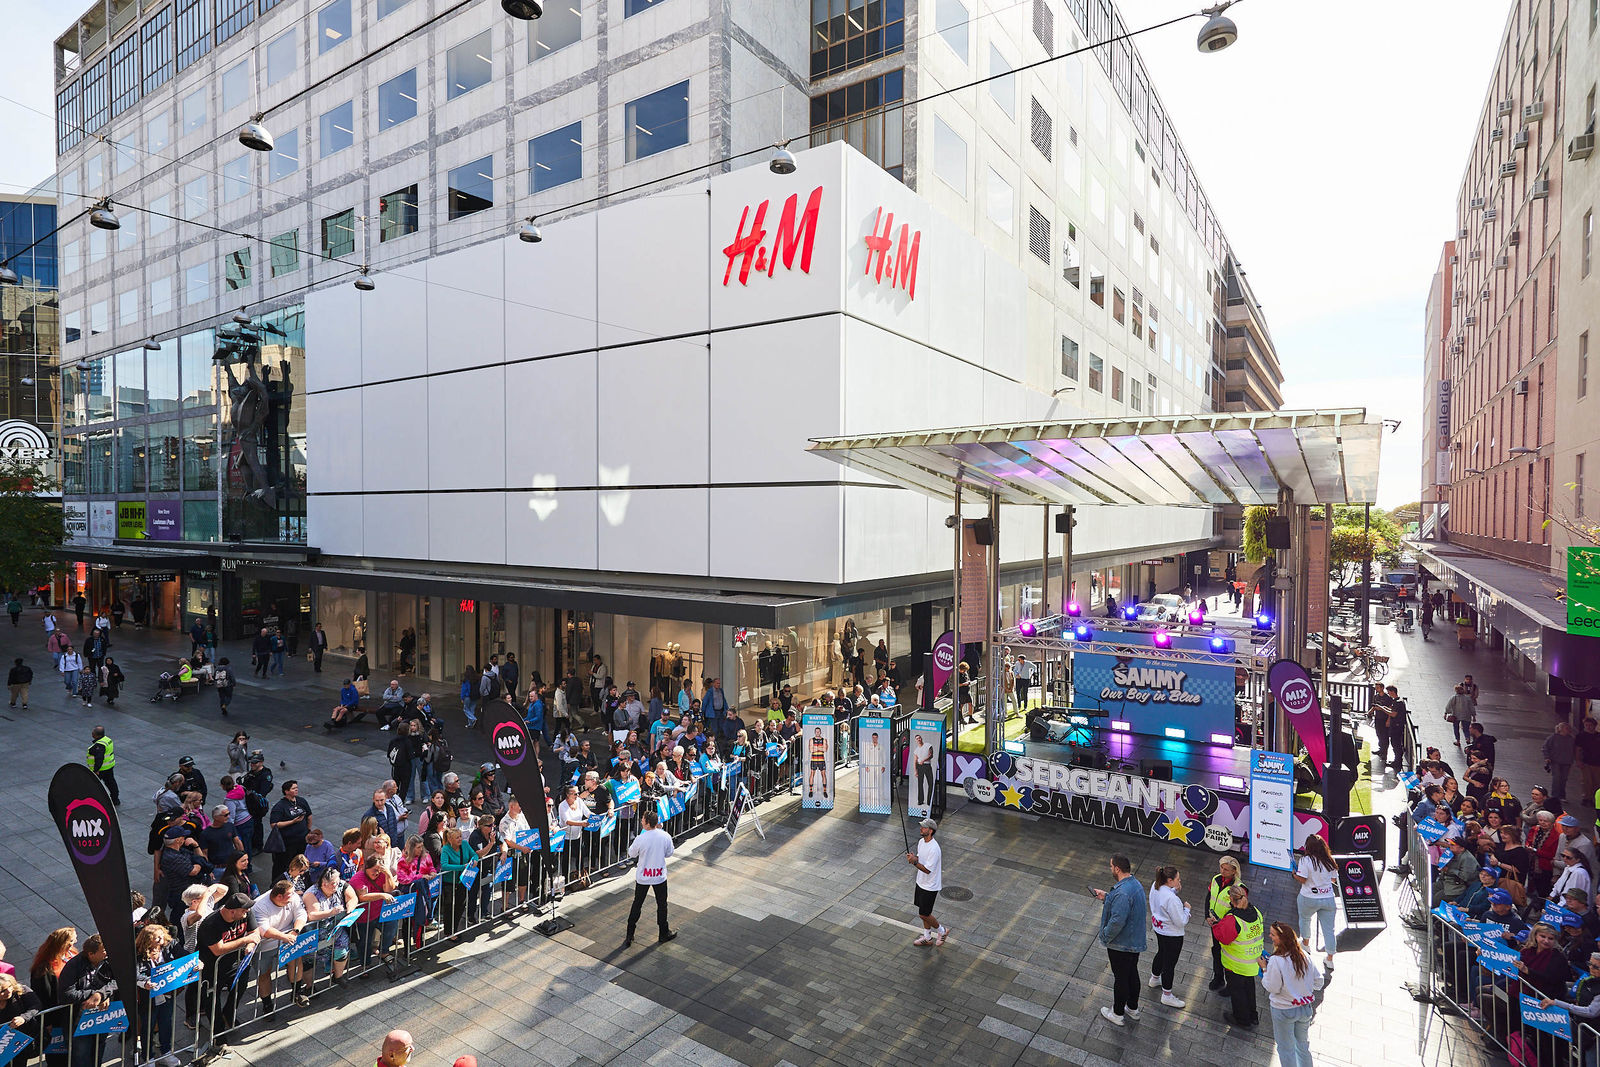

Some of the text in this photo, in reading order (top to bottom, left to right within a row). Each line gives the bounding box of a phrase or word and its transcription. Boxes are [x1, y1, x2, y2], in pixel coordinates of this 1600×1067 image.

[723, 186, 823, 287] H&M
[865, 206, 921, 301] H&M
[0, 448, 50, 459] YER
[120, 507, 129, 519] JB
[1114, 667, 1186, 690] SAMMY
[1101, 687, 1201, 703] Our Boy in Blue
[1286, 688, 1308, 702] MIX
[498, 735, 522, 749] MIX
[1258, 760, 1284, 770] SAMMY
[1015, 756, 1183, 812] SERGEANT
[1031, 788, 1163, 838] SAMMY
[73, 818, 105, 838] MIX
[1207, 828, 1227, 838] SIGN
[1205, 832, 1229, 843] FAIRY
[1354, 832, 1369, 840] MIX
[78, 839, 100, 848] 102.3
[643, 867, 663, 877] MIX
[381, 896, 415, 918] GO SAMMY
[1544, 914, 1553, 922] GO
[280, 952, 291, 963] GO
[1481, 949, 1518, 964] GO SAMMY
[166, 956, 198, 984] SAMMY
[79, 1008, 127, 1031] GO SAMM
[1523, 1010, 1568, 1025] GO SAMMY
